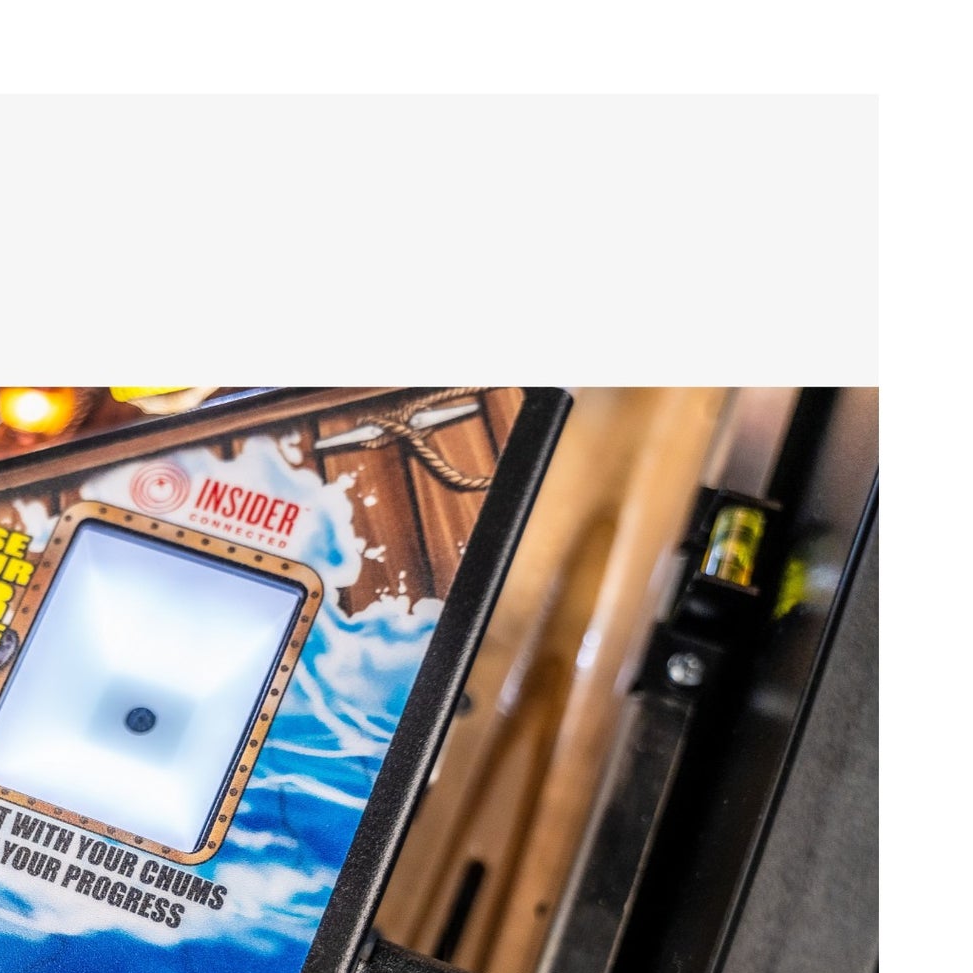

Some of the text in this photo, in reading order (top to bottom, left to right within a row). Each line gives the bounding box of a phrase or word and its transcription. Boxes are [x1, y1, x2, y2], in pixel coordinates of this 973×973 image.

[189, 513, 287, 549] CONNECTED
[195, 479, 300, 536] INSIDER
[0, 840, 59, 886] YOUR
[60, 862, 186, 929] PROGRESS
[10, 813, 74, 853] WITH
[77, 836, 137, 878] YOUR
[139, 858, 228, 911] CHUMS
